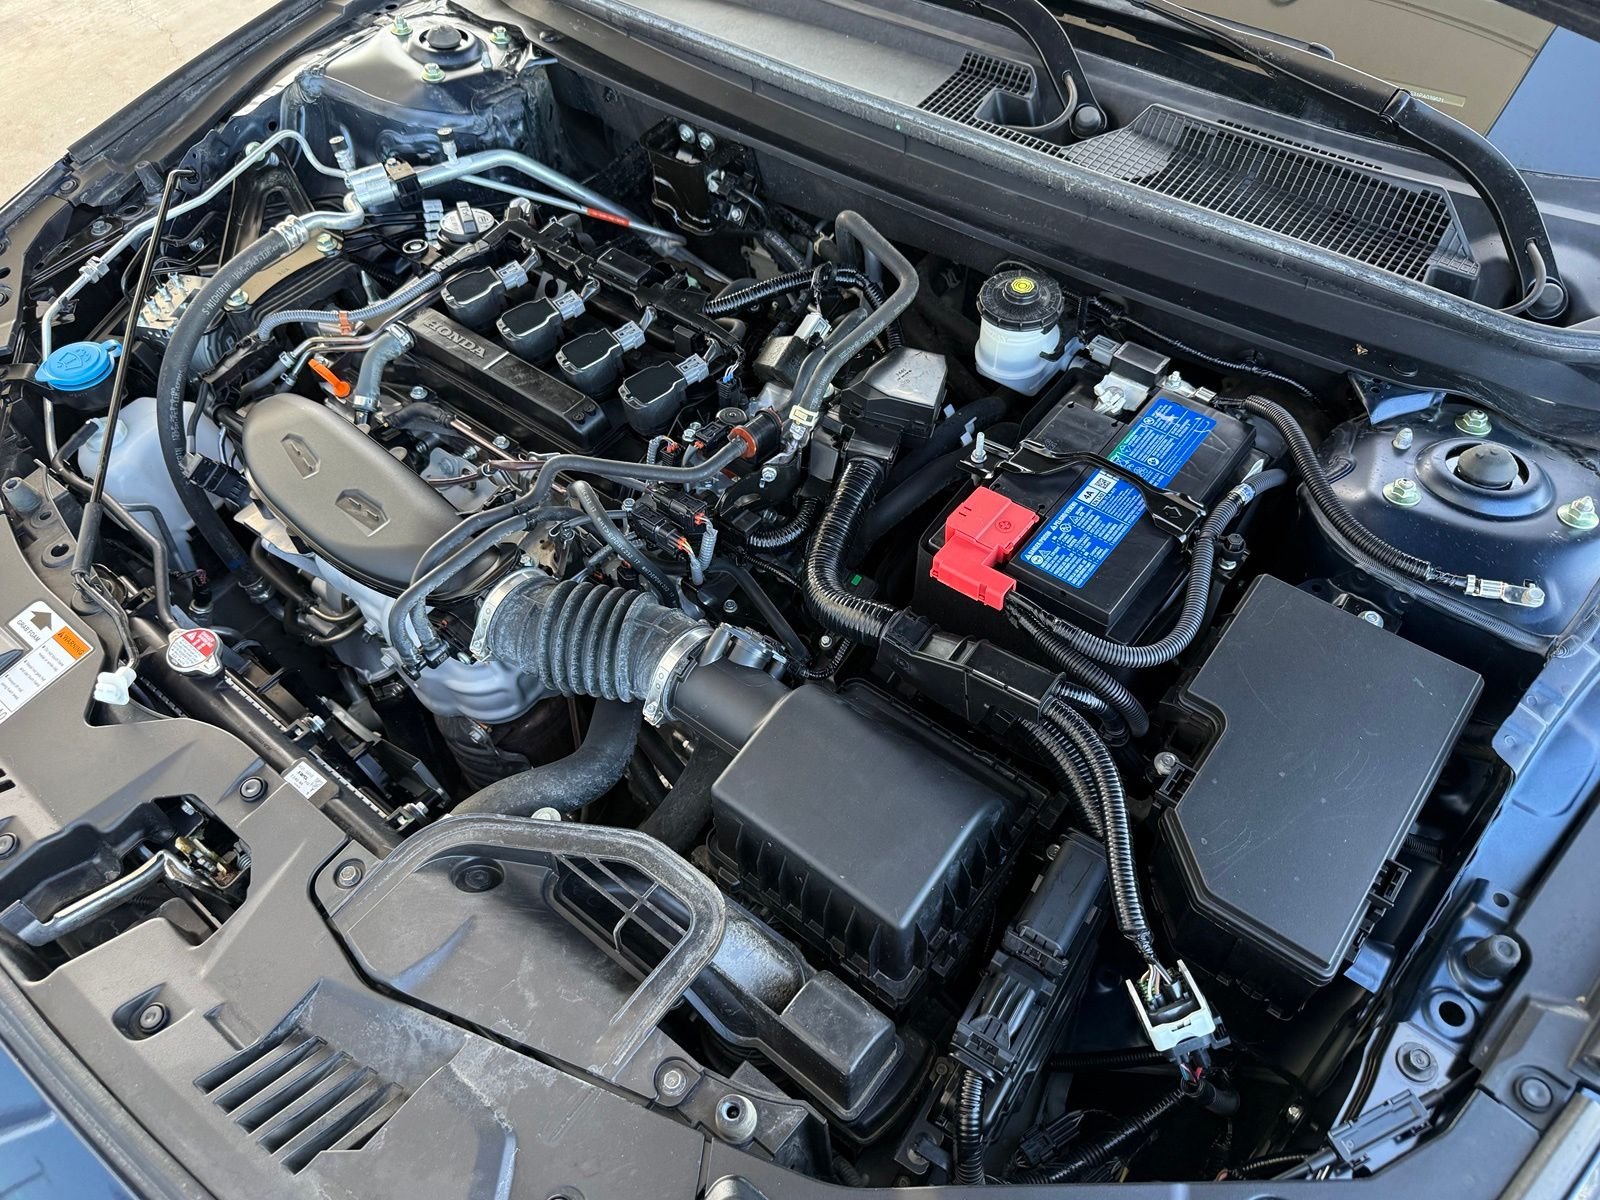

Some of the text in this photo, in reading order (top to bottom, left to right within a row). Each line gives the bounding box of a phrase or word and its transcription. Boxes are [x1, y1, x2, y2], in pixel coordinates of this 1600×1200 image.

[424, 321, 486, 358] HONDA
[1083, 490, 1095, 500] 4A
[16, 619, 41, 642] GRAB FOAM
[62, 634, 85, 656] WARNING
